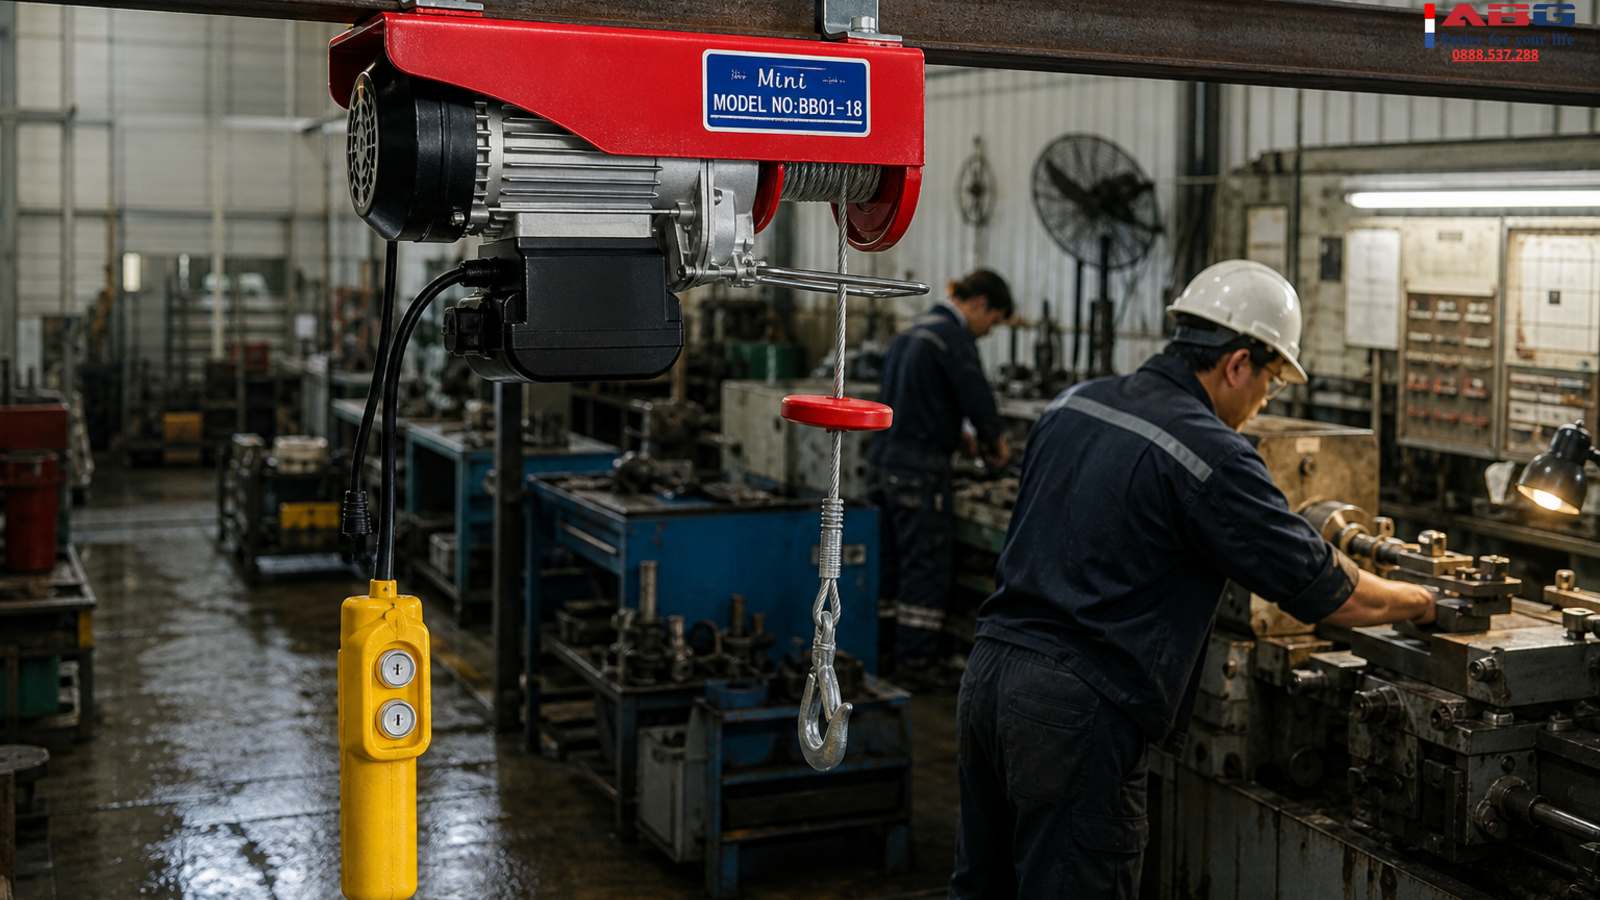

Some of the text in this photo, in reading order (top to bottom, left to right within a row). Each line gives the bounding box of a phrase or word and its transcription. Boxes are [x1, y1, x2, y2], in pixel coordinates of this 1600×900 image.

[758, 68, 807, 89] Mini
[713, 94, 863, 117] MODEL NO:BB01-18
